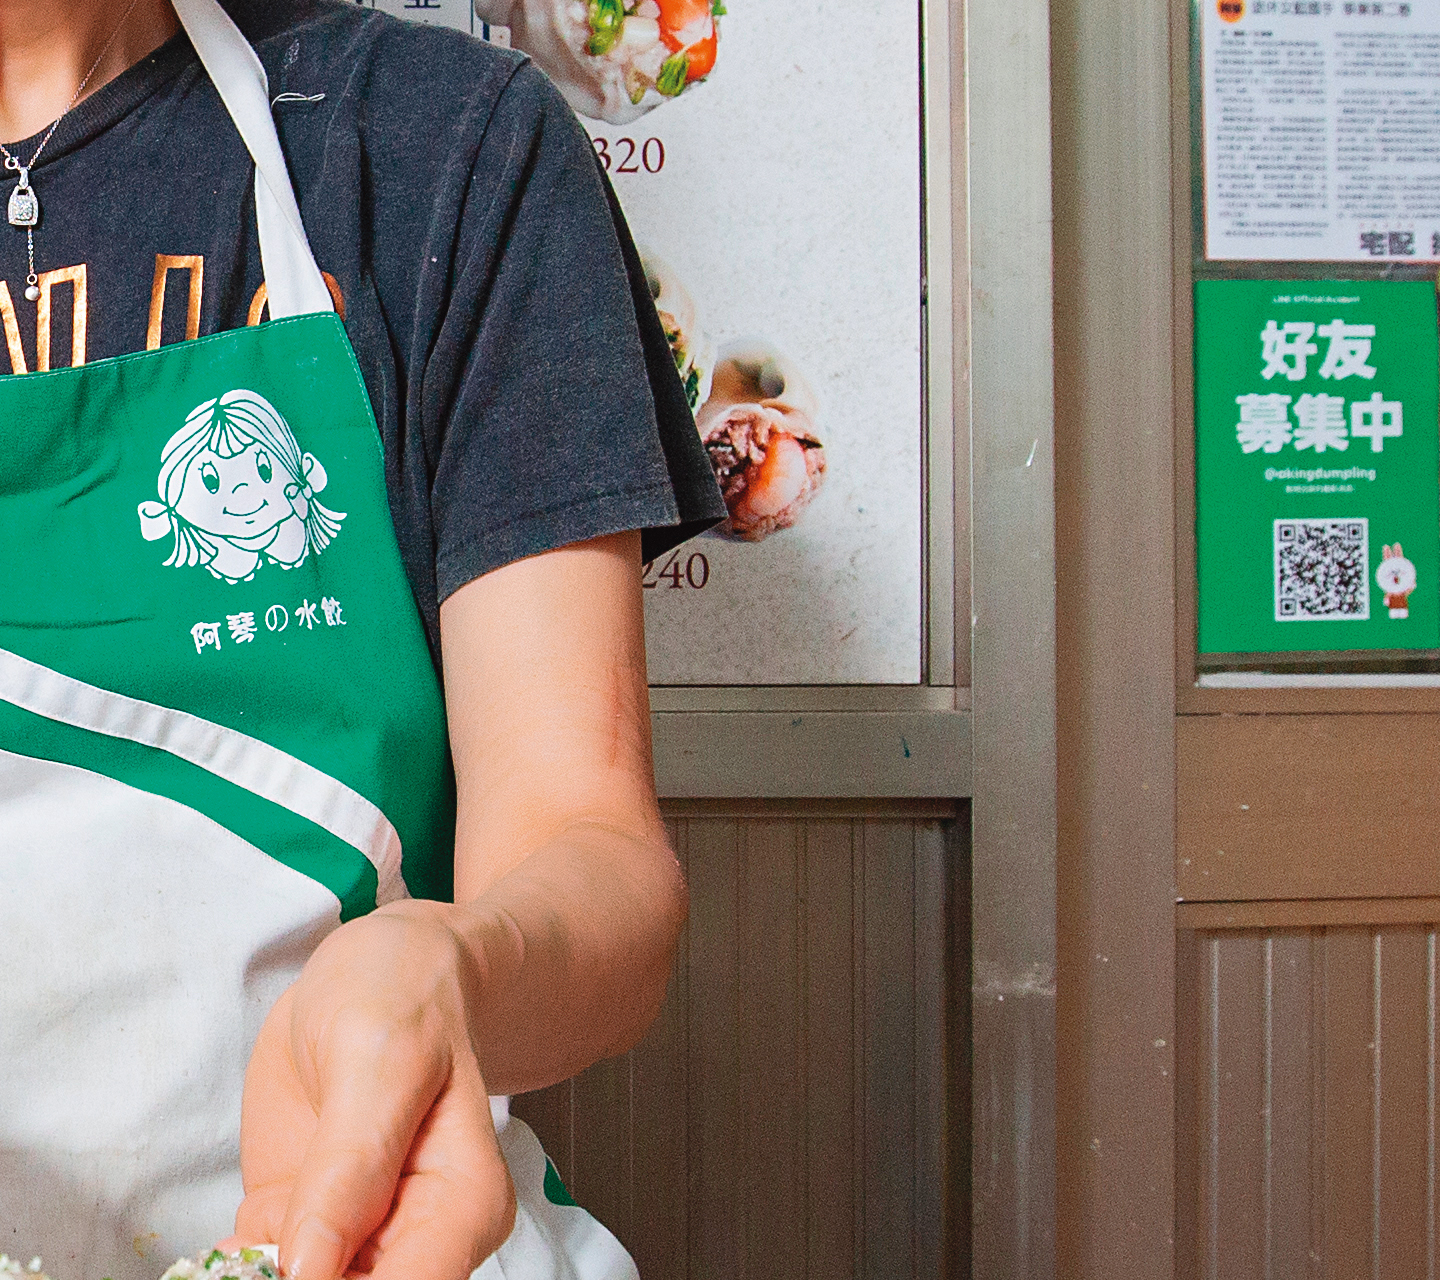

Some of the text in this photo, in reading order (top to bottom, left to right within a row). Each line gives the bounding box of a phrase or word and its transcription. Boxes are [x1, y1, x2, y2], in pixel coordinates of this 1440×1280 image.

[1260, 319, 1377, 381] 好友
[1236, 392, 1403, 453] 募集中
